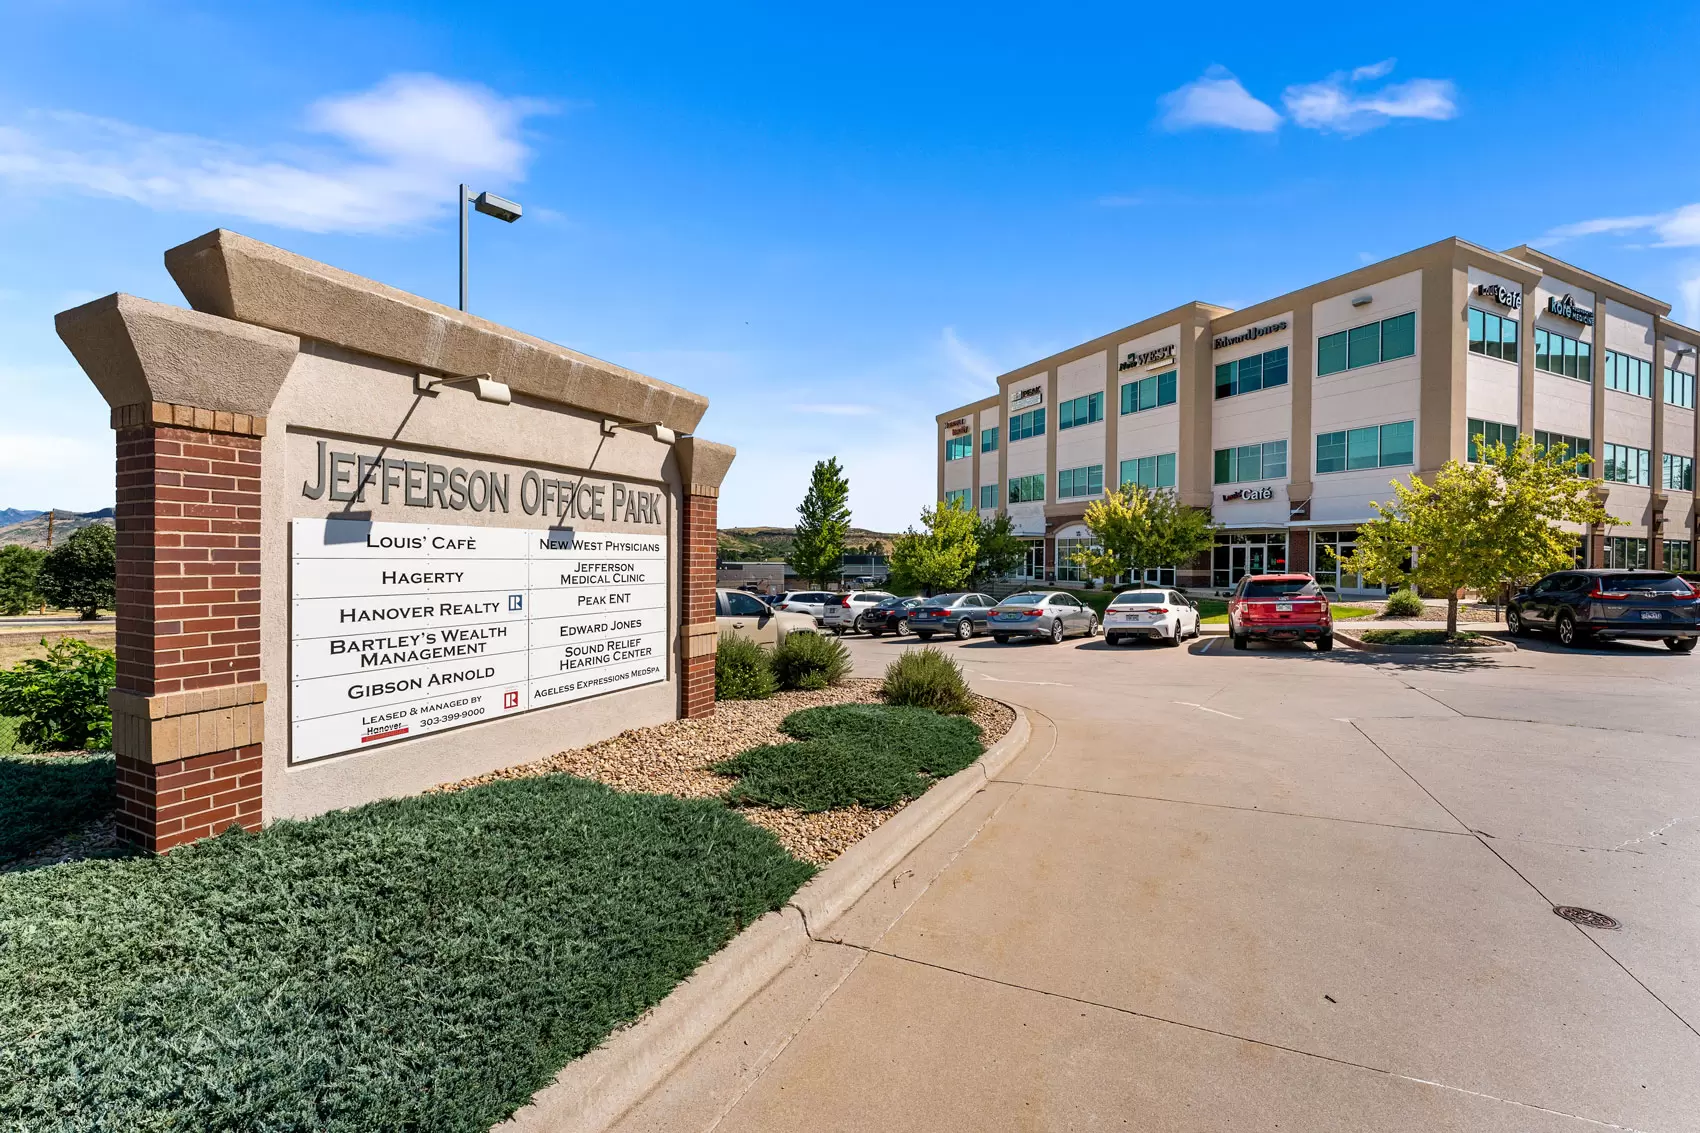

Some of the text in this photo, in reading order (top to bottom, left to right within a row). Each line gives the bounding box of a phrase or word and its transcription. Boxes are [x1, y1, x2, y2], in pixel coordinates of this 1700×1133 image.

[1137, 344, 1176, 365] WEST
[302, 441, 661, 525] JEFFERSON OFFICE PARK
[540, 538, 660, 552] NEW WEST PHYSICIANS
[382, 571, 464, 584] HAGERTY
[574, 562, 634, 573] JEFFERSON
[560, 573, 645, 585] MEDICAL CLINIC
[578, 593, 631, 606] PEAK ENT
[340, 606, 435, 623] HANOVER
[439, 602, 500, 617] REALTY
[560, 619, 642, 637] EDWARD JONES
[330, 626, 507, 655] BARTLEY'S WEALTH
[565, 638, 641, 658] SOUND RELIEF
[360, 642, 487, 667] MANAGEMENT
[560, 647, 652, 671] HEARING CENTER
[348, 667, 495, 699] GIBSON ARNOLD
[534, 683, 575, 698] AGELESS
[576, 672, 630, 689] EXPRESSIONS
[362, 695, 482, 725] LEASED & MANAGED BY
[420, 707, 485, 728] 303-399-9000
[366, 722, 402, 735] Hanover
